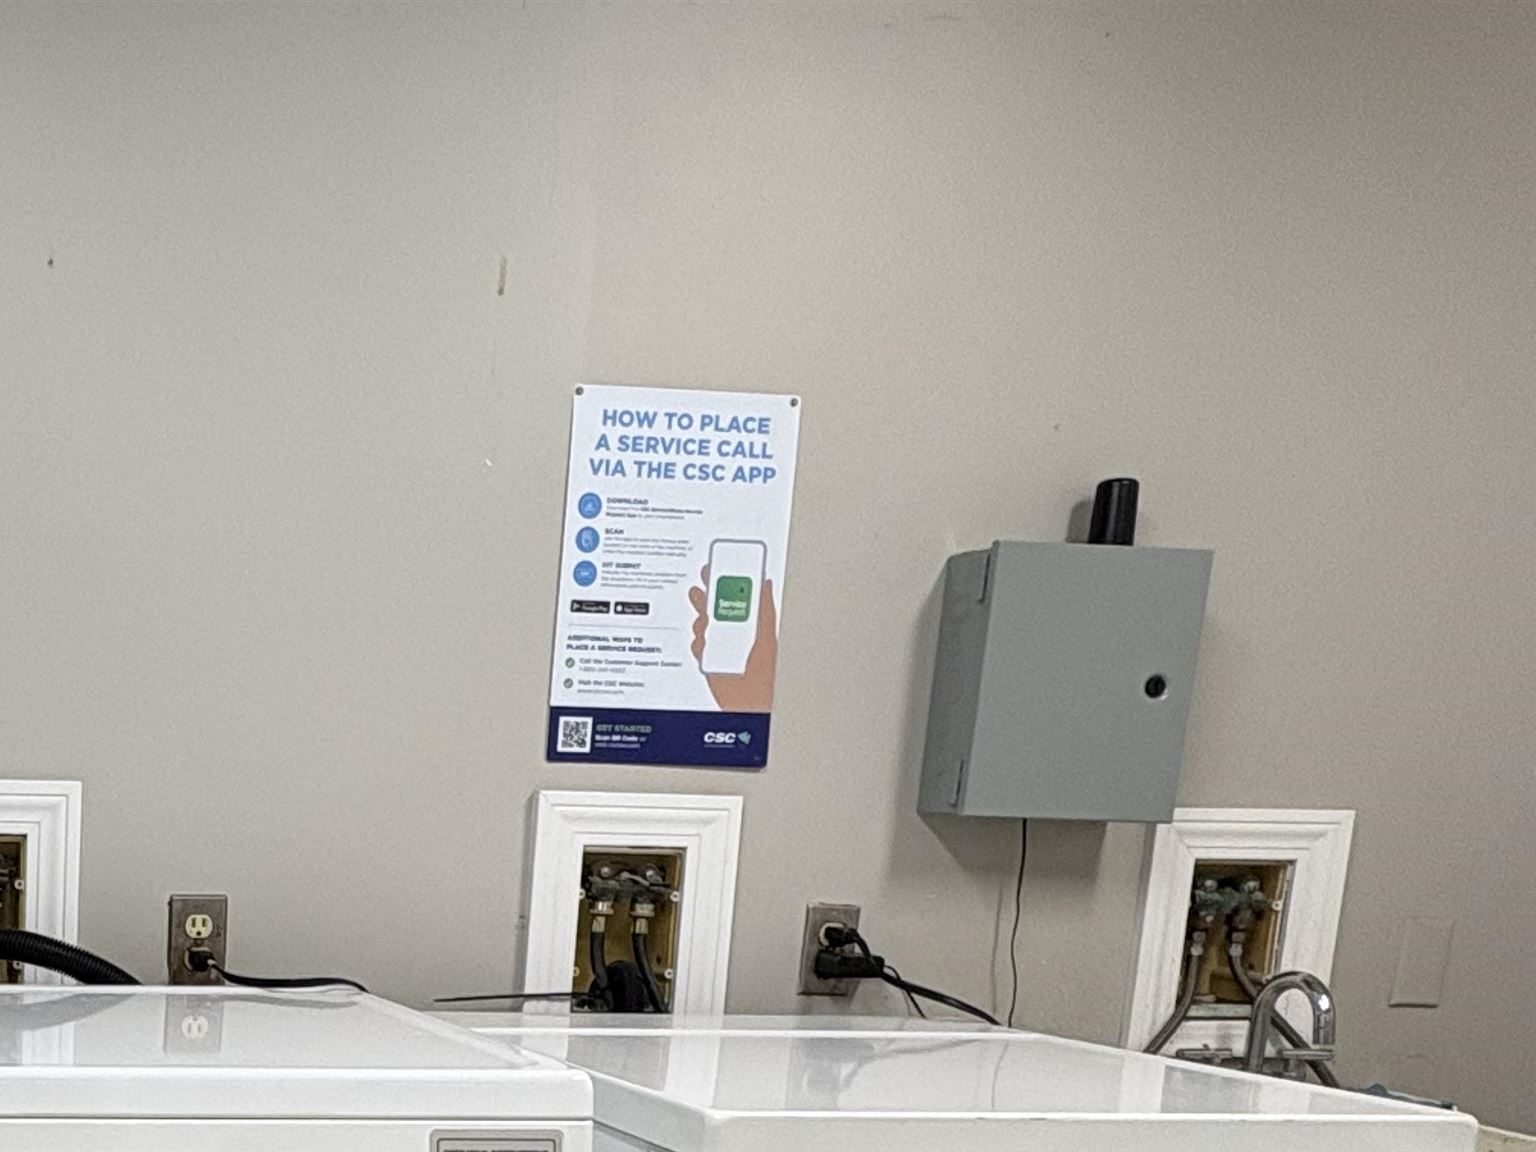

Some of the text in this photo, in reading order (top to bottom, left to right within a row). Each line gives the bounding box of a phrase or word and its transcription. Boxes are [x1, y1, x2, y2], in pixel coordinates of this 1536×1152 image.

[602, 409, 771, 434] HOW TO PLACE
[595, 434, 773, 459] A SERVICE CALL
[589, 458, 776, 484] VIA THE CSC APP
[607, 497, 649, 505] DOWNLOAD
[596, 724, 652, 734] GET STARTED
[704, 732, 736, 744] CSC
